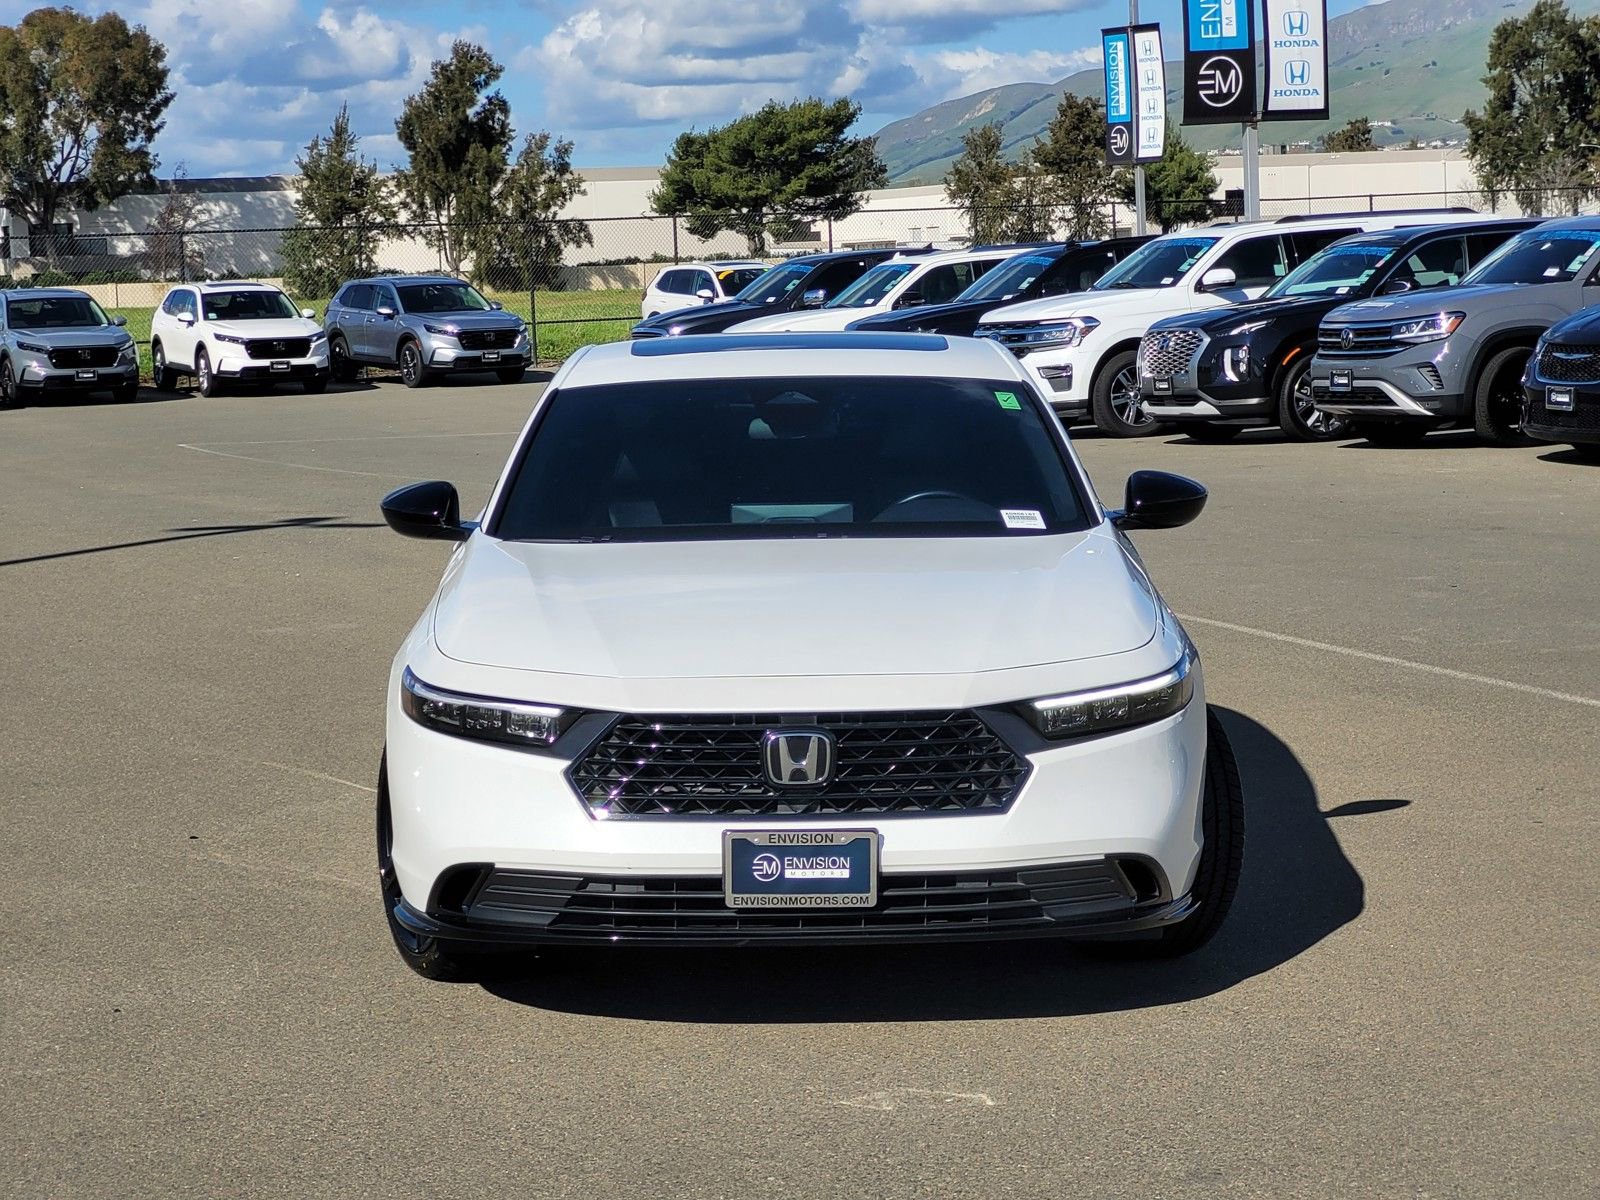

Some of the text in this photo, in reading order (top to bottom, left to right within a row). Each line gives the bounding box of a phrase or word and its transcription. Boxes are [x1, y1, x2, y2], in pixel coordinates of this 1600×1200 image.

[1273, 39, 1320, 48] HONDA
[1108, 42, 1120, 116] ENVISION
[1273, 88, 1321, 97] HONDA
[768, 834, 834, 844] ENVISION
[784, 857, 850, 869] ENVISION
[733, 896, 869, 906] ENVISIONMOTORS.COM
